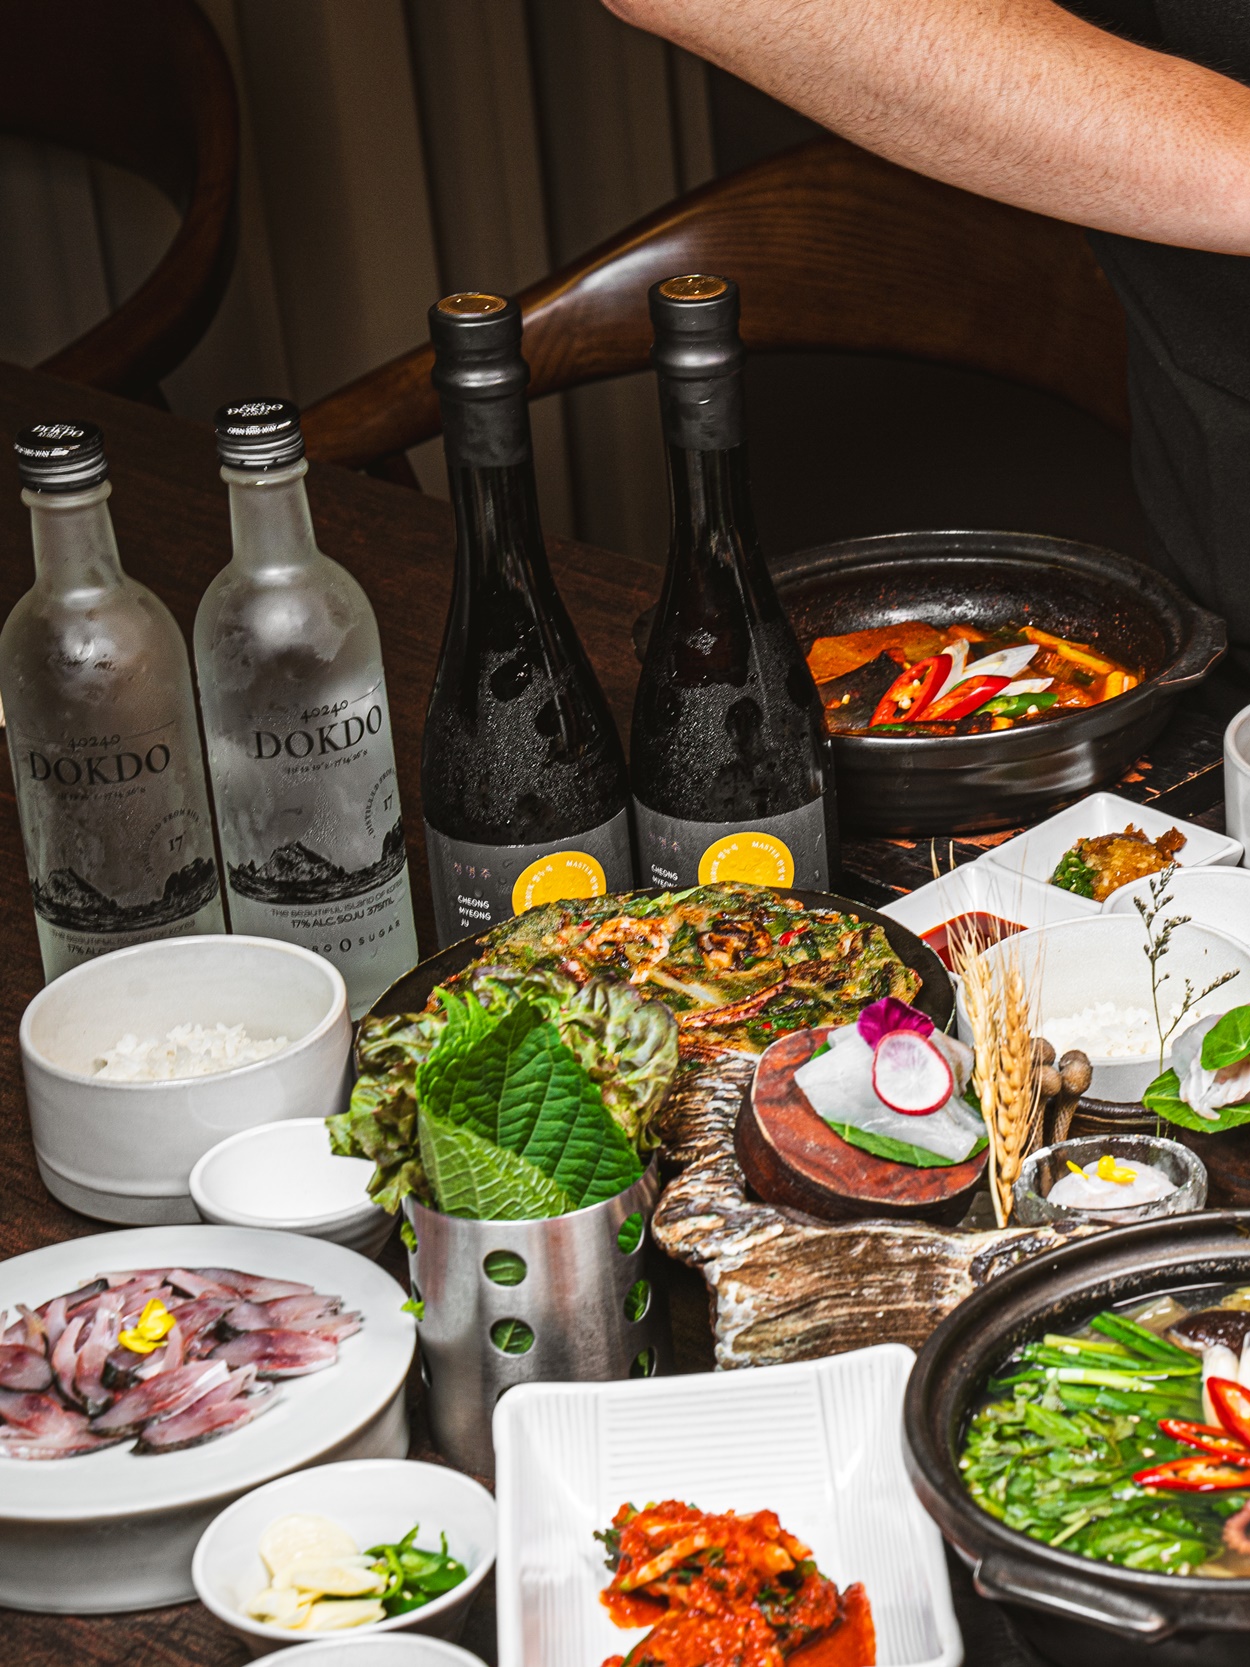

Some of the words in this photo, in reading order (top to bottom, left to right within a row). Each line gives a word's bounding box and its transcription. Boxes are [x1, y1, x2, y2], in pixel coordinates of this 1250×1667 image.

[300, 700, 349, 724] 40240
[252, 705, 382, 759] DOKDO
[67, 734, 121, 752] 40240
[27, 743, 171, 786] DOKDO
[751, 841, 781, 859] MASTER
[566, 860, 593, 877] MASTER
[651, 864, 678, 881] CHEONG
[457, 894, 490, 910] CHEONG
[458, 906, 492, 921] MYEONG
[291, 919, 311, 929] 17%
[461, 918, 470, 928] JU
[358, 919, 401, 946] SUGAR
